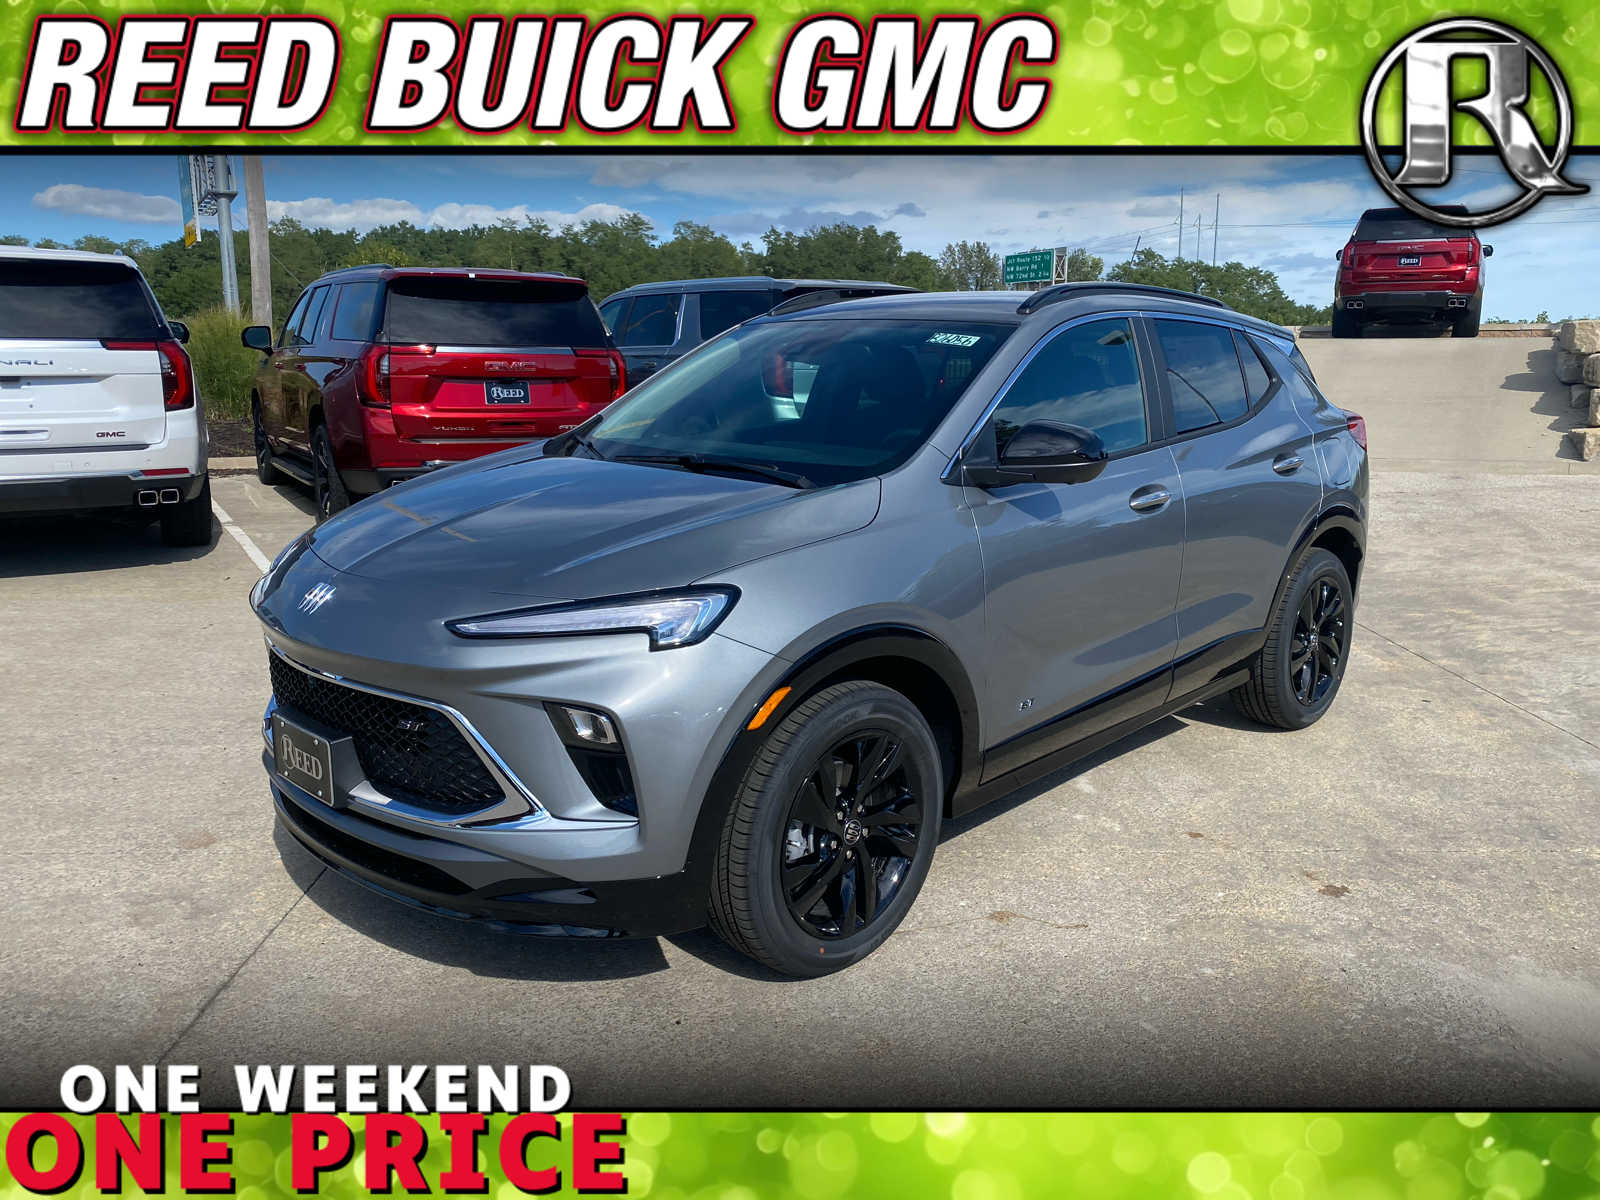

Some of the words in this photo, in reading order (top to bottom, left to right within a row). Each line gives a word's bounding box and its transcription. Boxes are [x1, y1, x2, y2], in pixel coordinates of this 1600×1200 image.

[484, 360, 537, 372] GMC
[490, 386, 525, 400] REED
[280, 734, 323, 781] REED
